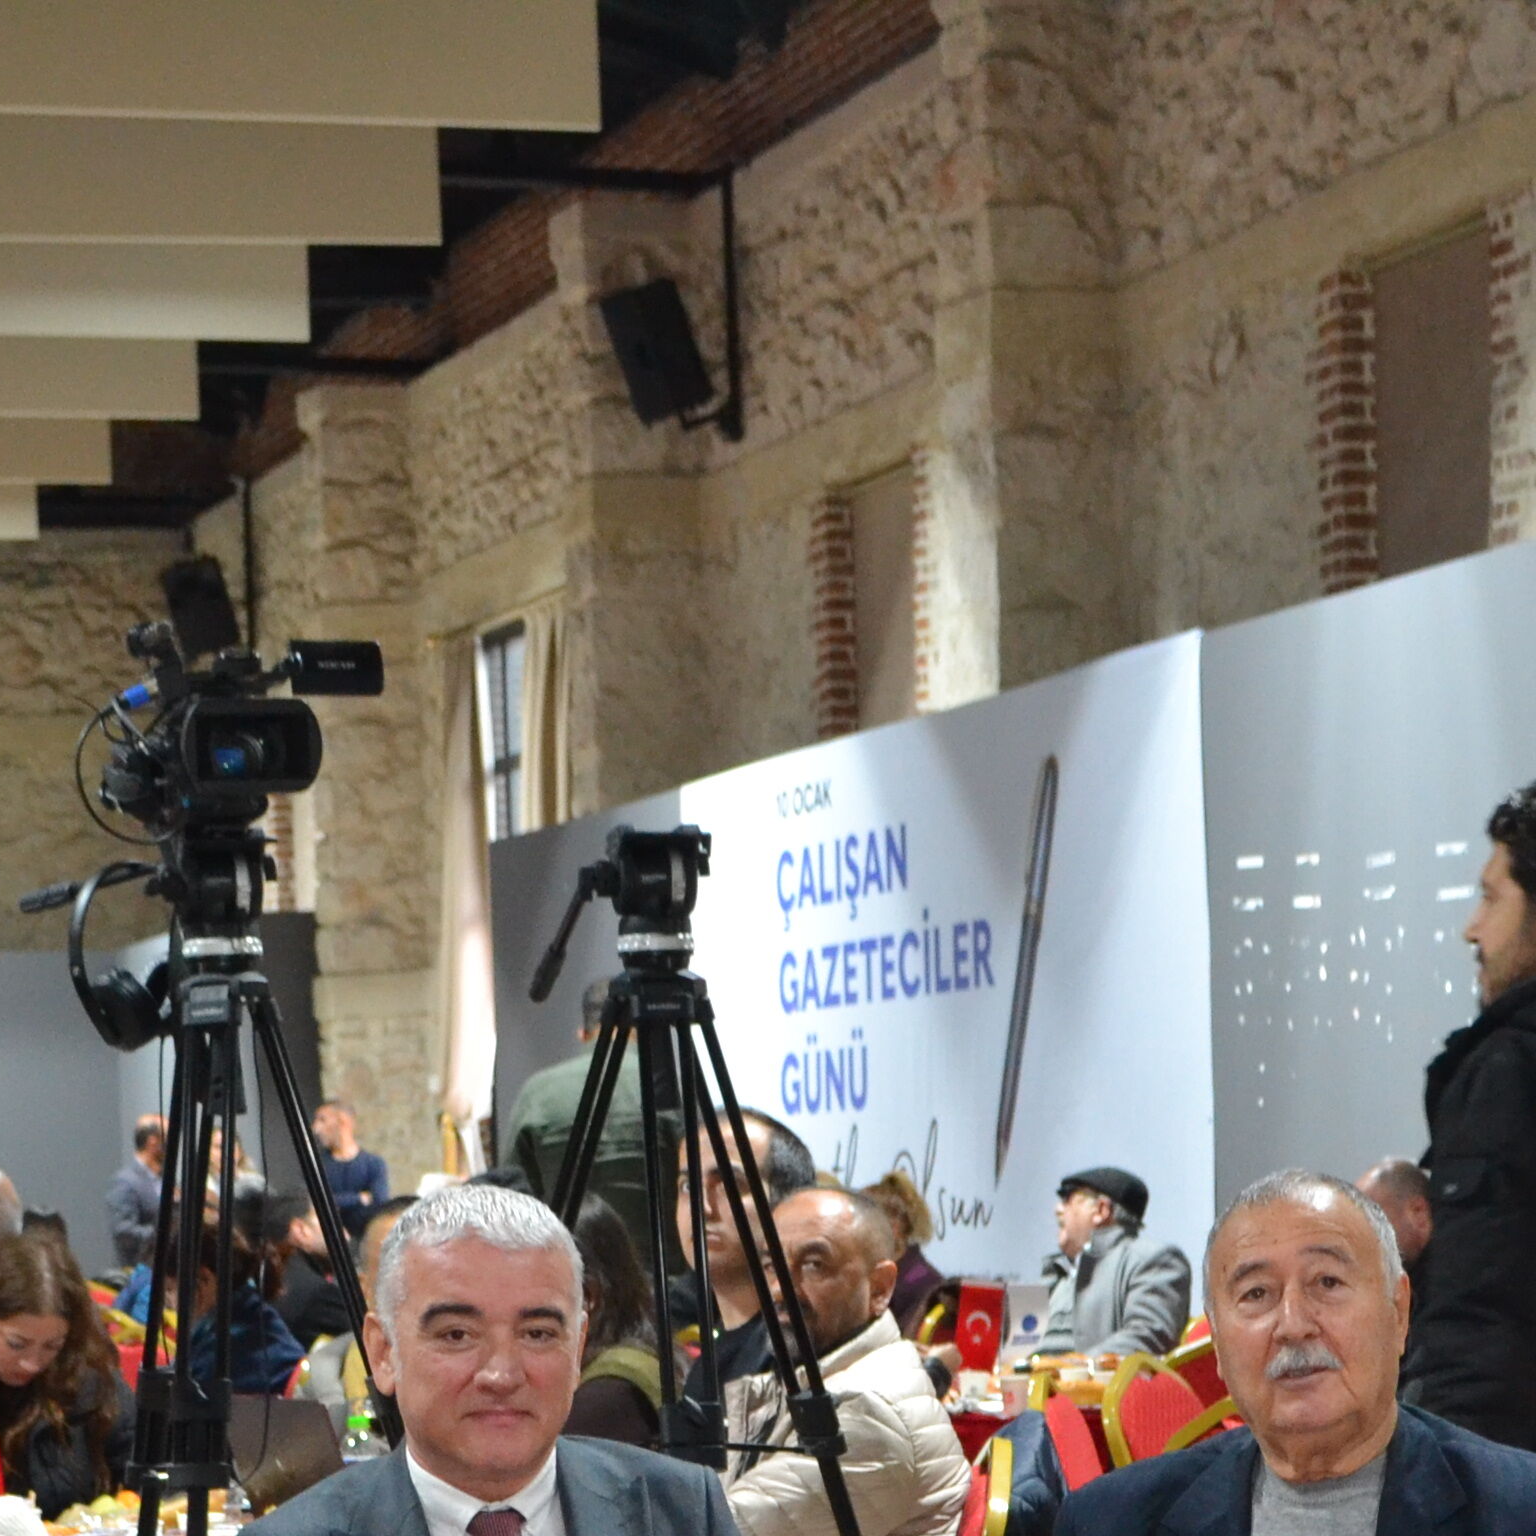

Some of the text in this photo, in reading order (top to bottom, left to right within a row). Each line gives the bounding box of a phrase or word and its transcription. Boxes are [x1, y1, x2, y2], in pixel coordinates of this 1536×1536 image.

[792, 778, 832, 815] OCAK
[776, 823, 908, 931] ÇALIŞAN
[779, 910, 995, 1014] GAZETECİLER
[781, 1027, 868, 1115] GÜNÜ
